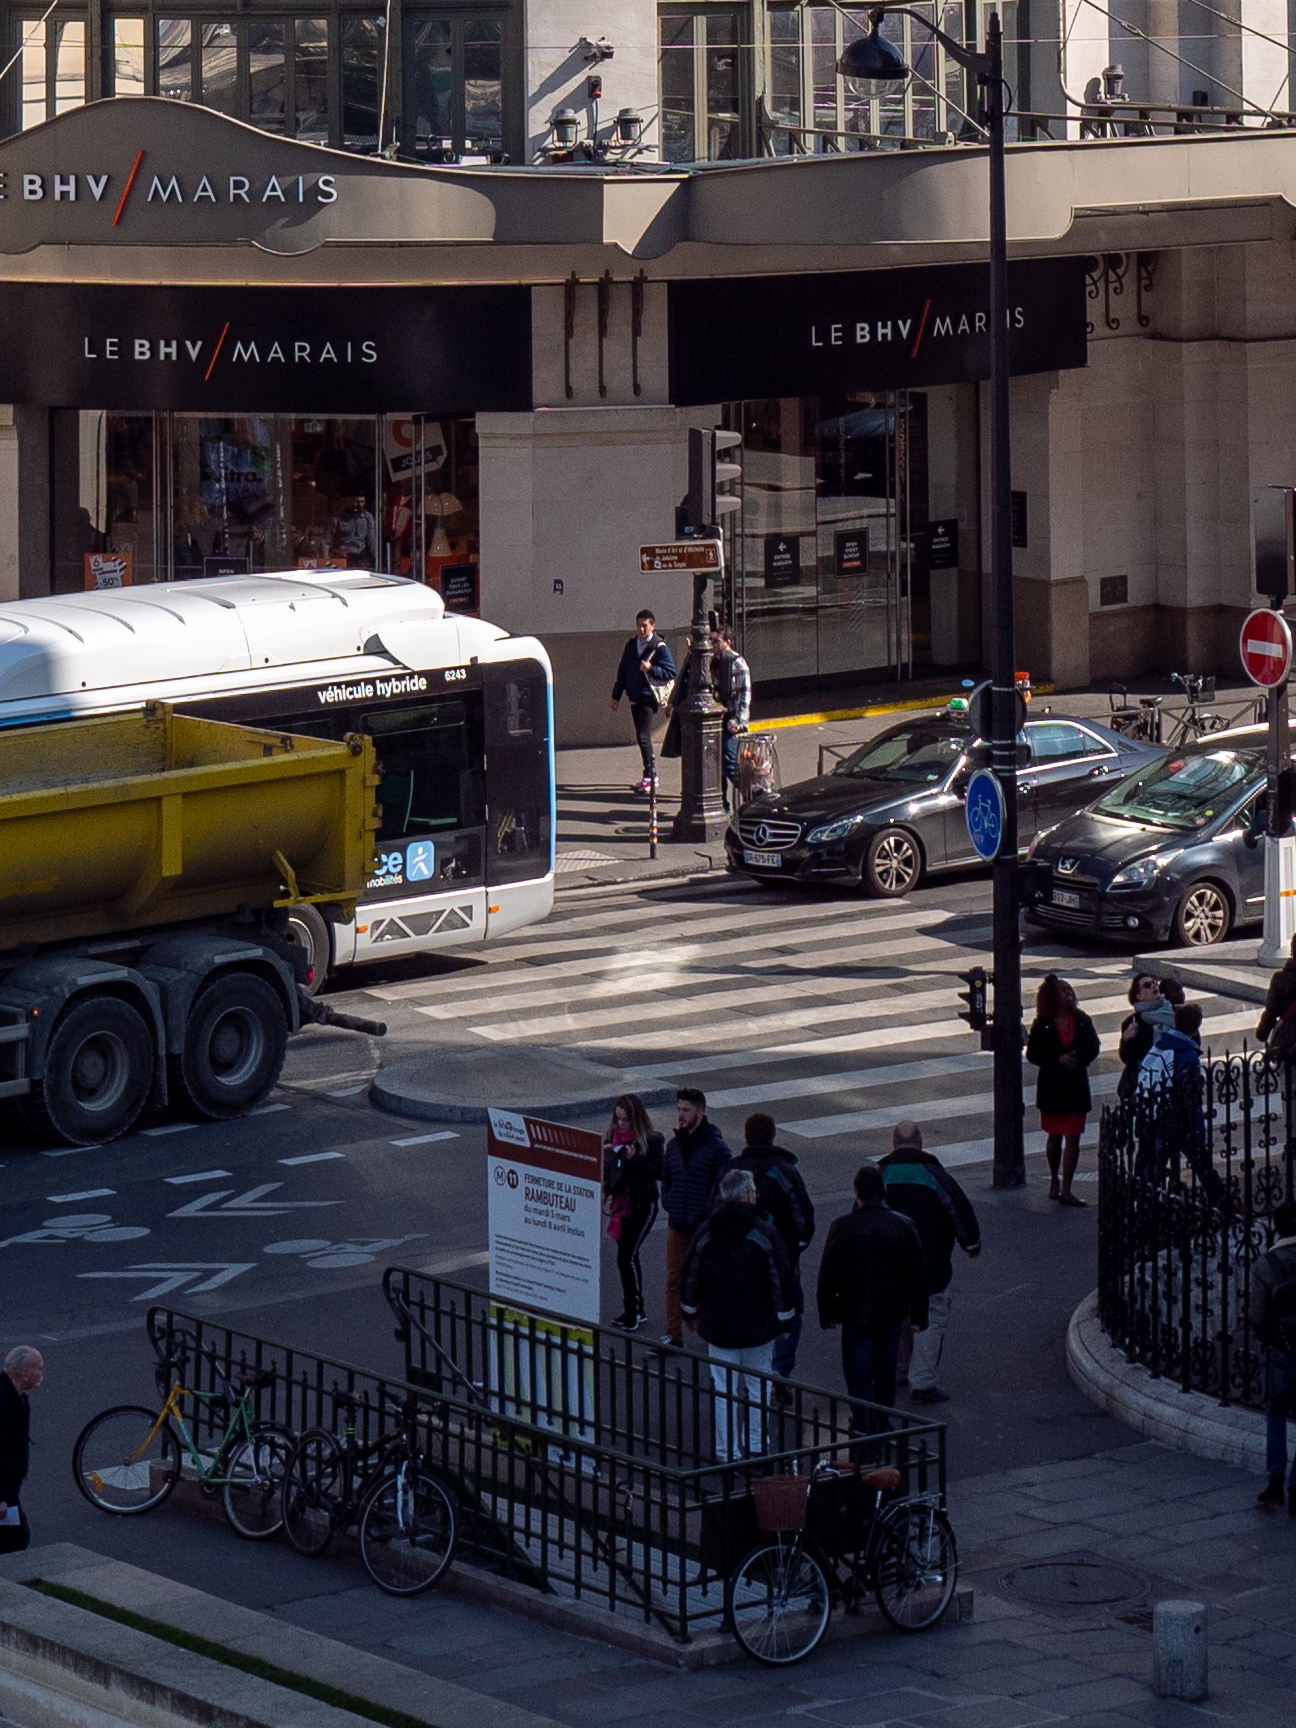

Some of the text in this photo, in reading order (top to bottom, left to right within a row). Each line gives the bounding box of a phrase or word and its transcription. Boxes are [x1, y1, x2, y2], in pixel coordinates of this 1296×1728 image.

[146, 174, 341, 205] MARAIS
[932, 306, 1026, 338] MARIS
[232, 339, 380, 365] MARAIS
[317, 668, 467, 705] véhicule hybride 6243
[509, 1173, 518, 1185] 11
[524, 1173, 555, 1191] FERMETURE
[556, 1184, 564, 1192] DE
[565, 1186, 572, 1194] LA
[572, 1187, 595, 1200] STATION
[524, 1186, 577, 1213] RAMBUTEAU
[524, 1204, 532, 1213] du
[533, 1207, 550, 1218] mardi
[556, 1213, 571, 1223] mars
[524, 1217, 532, 1225] au
[532, 1218, 548, 1229] lundi
[553, 1222, 566, 1234] avril
[566, 1225, 586, 1238] inclus
